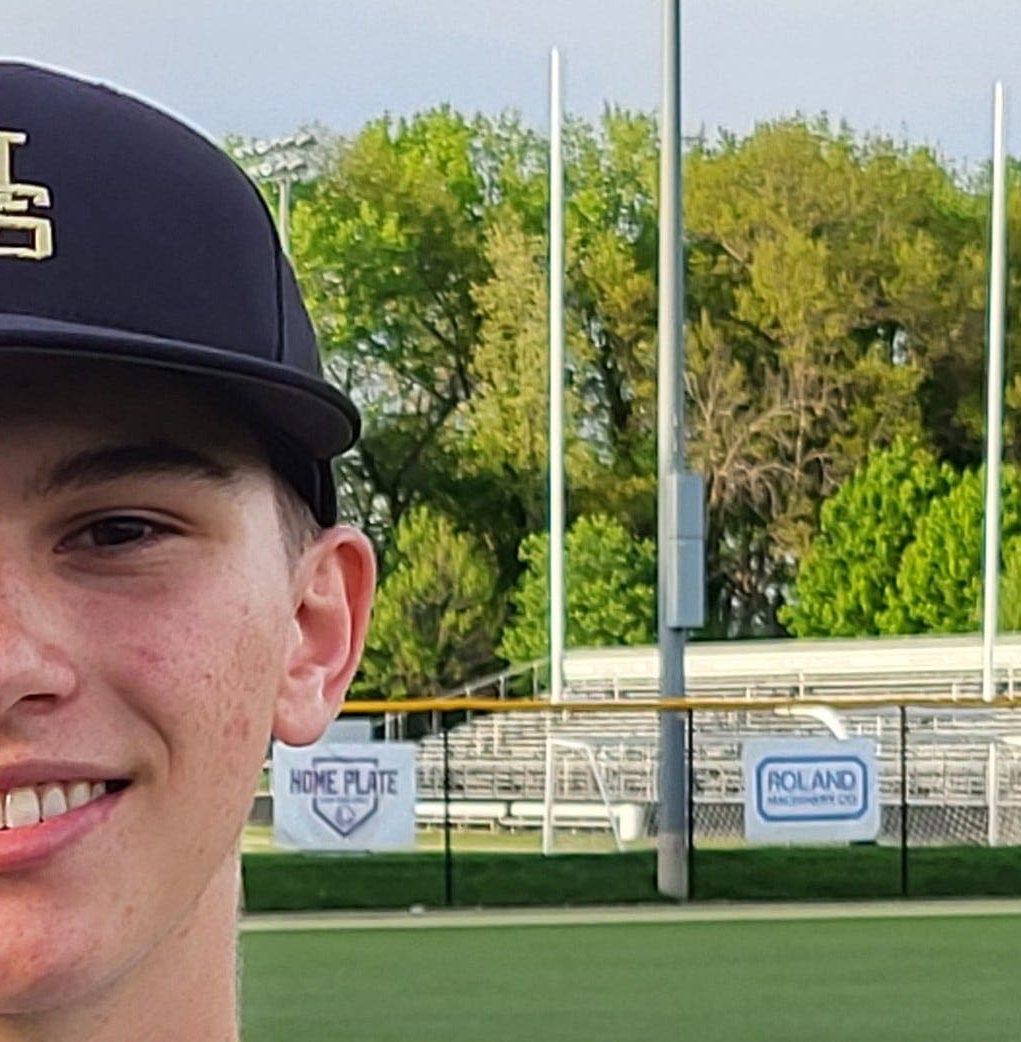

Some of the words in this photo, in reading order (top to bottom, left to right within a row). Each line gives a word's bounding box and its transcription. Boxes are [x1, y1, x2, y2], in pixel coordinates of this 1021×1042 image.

[289, 769, 337, 795] HOME
[344, 769, 398, 795] PLATE
[768, 769, 856, 791] ROLAND
